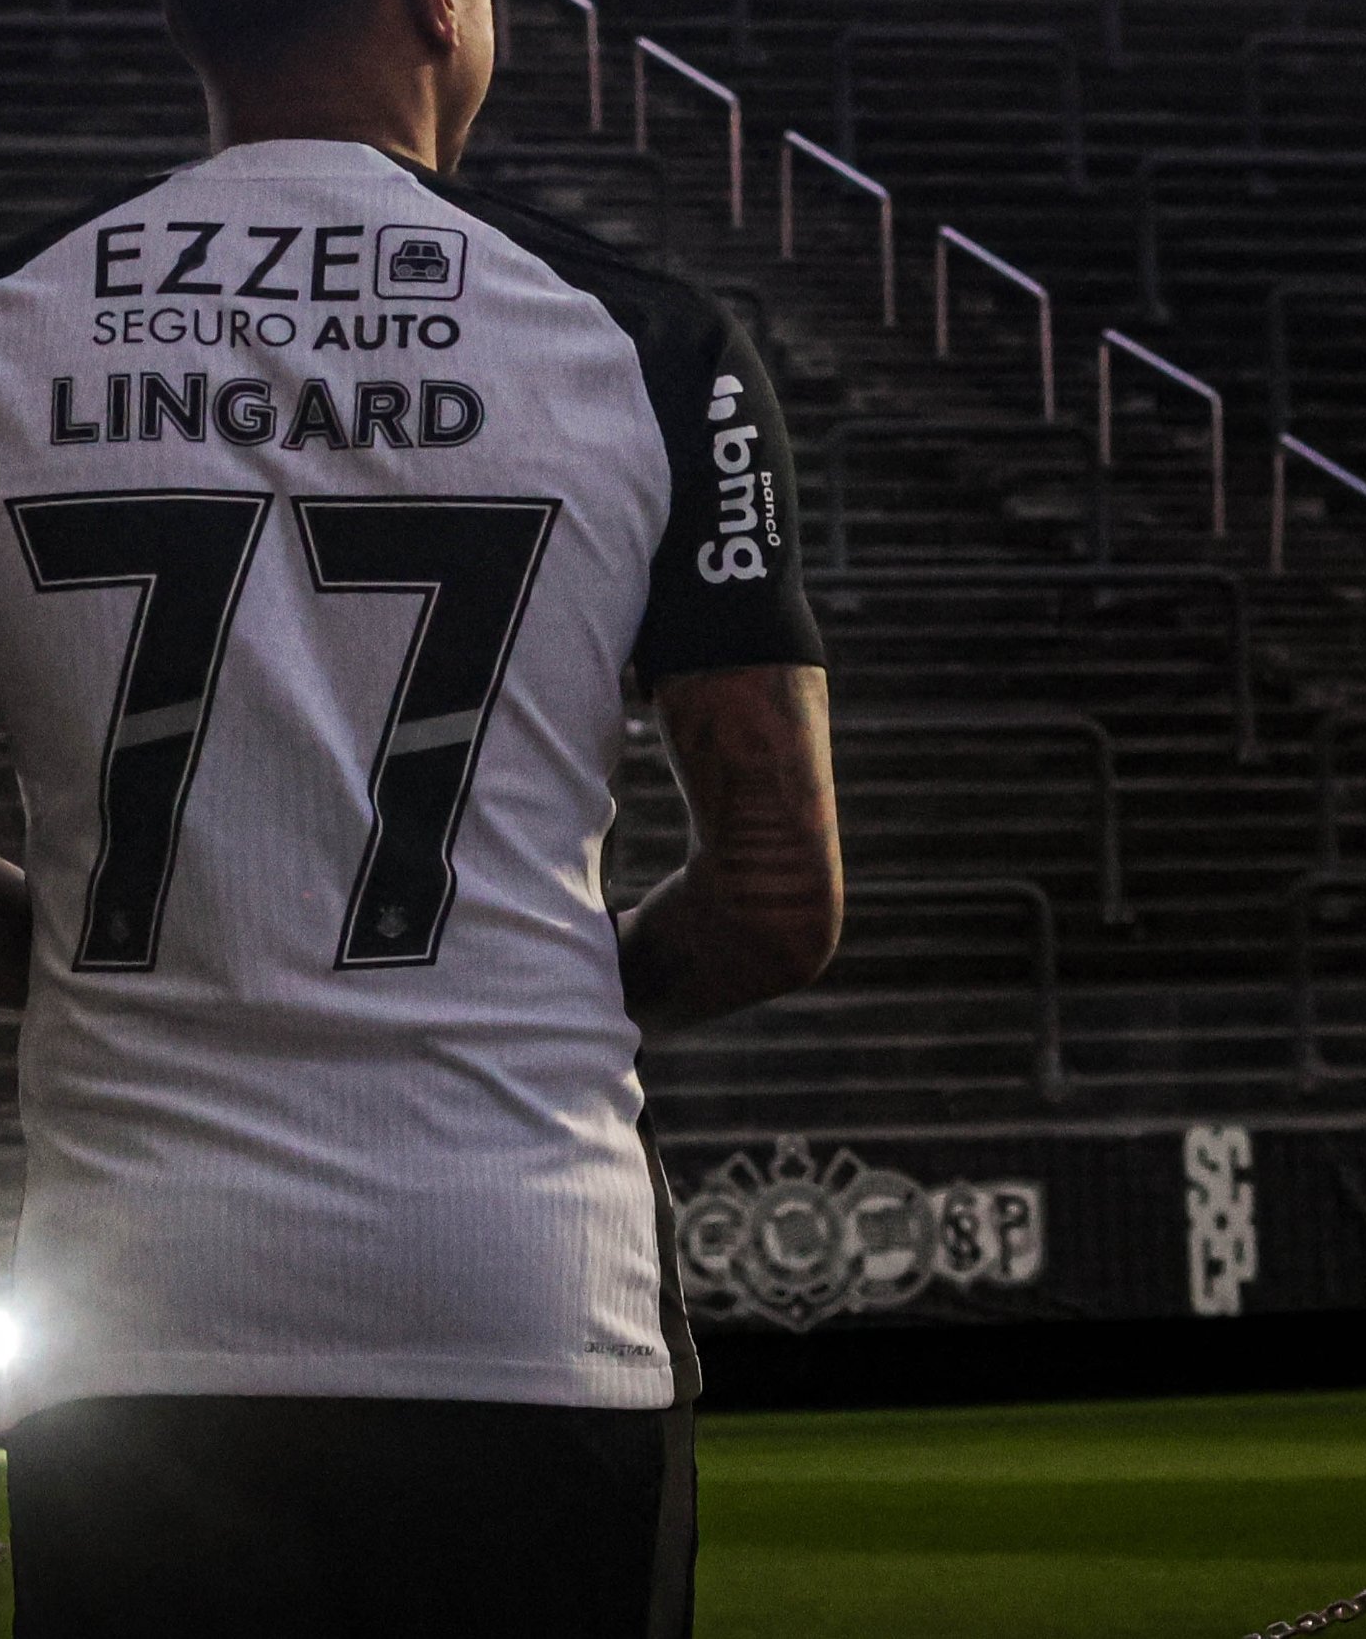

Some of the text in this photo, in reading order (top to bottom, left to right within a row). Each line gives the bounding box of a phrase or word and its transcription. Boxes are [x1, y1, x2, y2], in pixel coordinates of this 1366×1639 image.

[95, 223, 365, 301] EZZE
[93, 308, 461, 350] SEGURO AUTO
[50, 372, 485, 450] LINGARD
[697, 424, 768, 584] bmg
[760, 471, 781, 547] banco
[4, 488, 562, 972] 77
